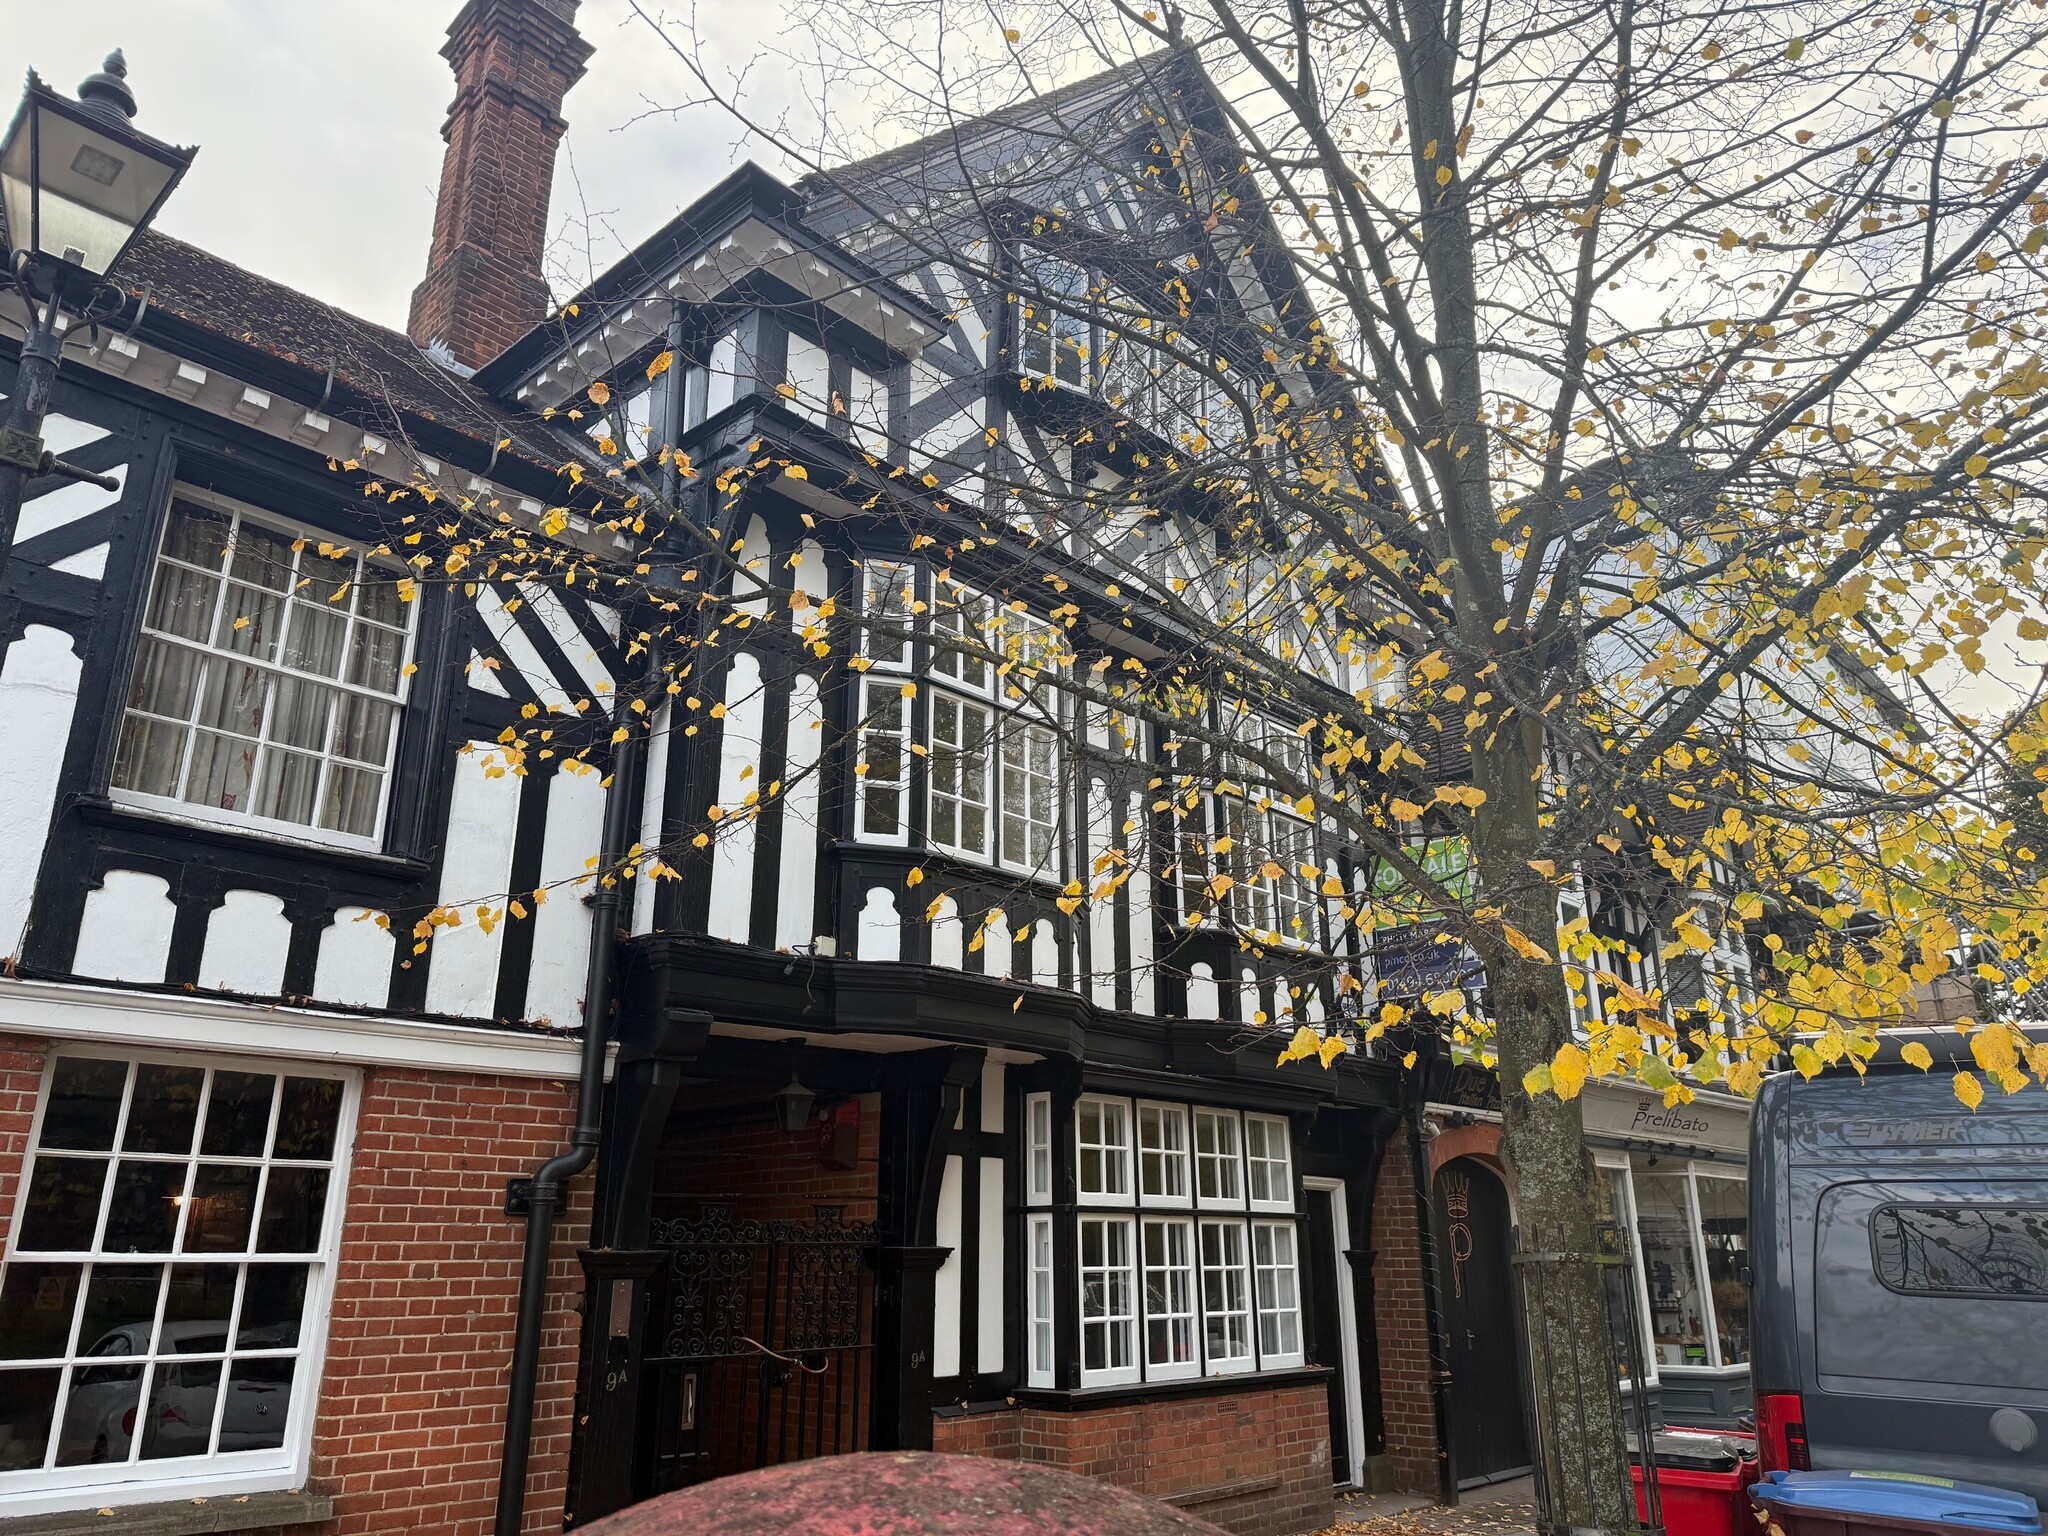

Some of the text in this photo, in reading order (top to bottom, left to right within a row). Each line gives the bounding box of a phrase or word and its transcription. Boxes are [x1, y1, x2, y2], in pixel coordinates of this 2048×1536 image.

[1866, 1122, 1960, 1141] HYMER
[910, 1349, 926, 1369] 9A
[605, 1368, 628, 1392] 9A
